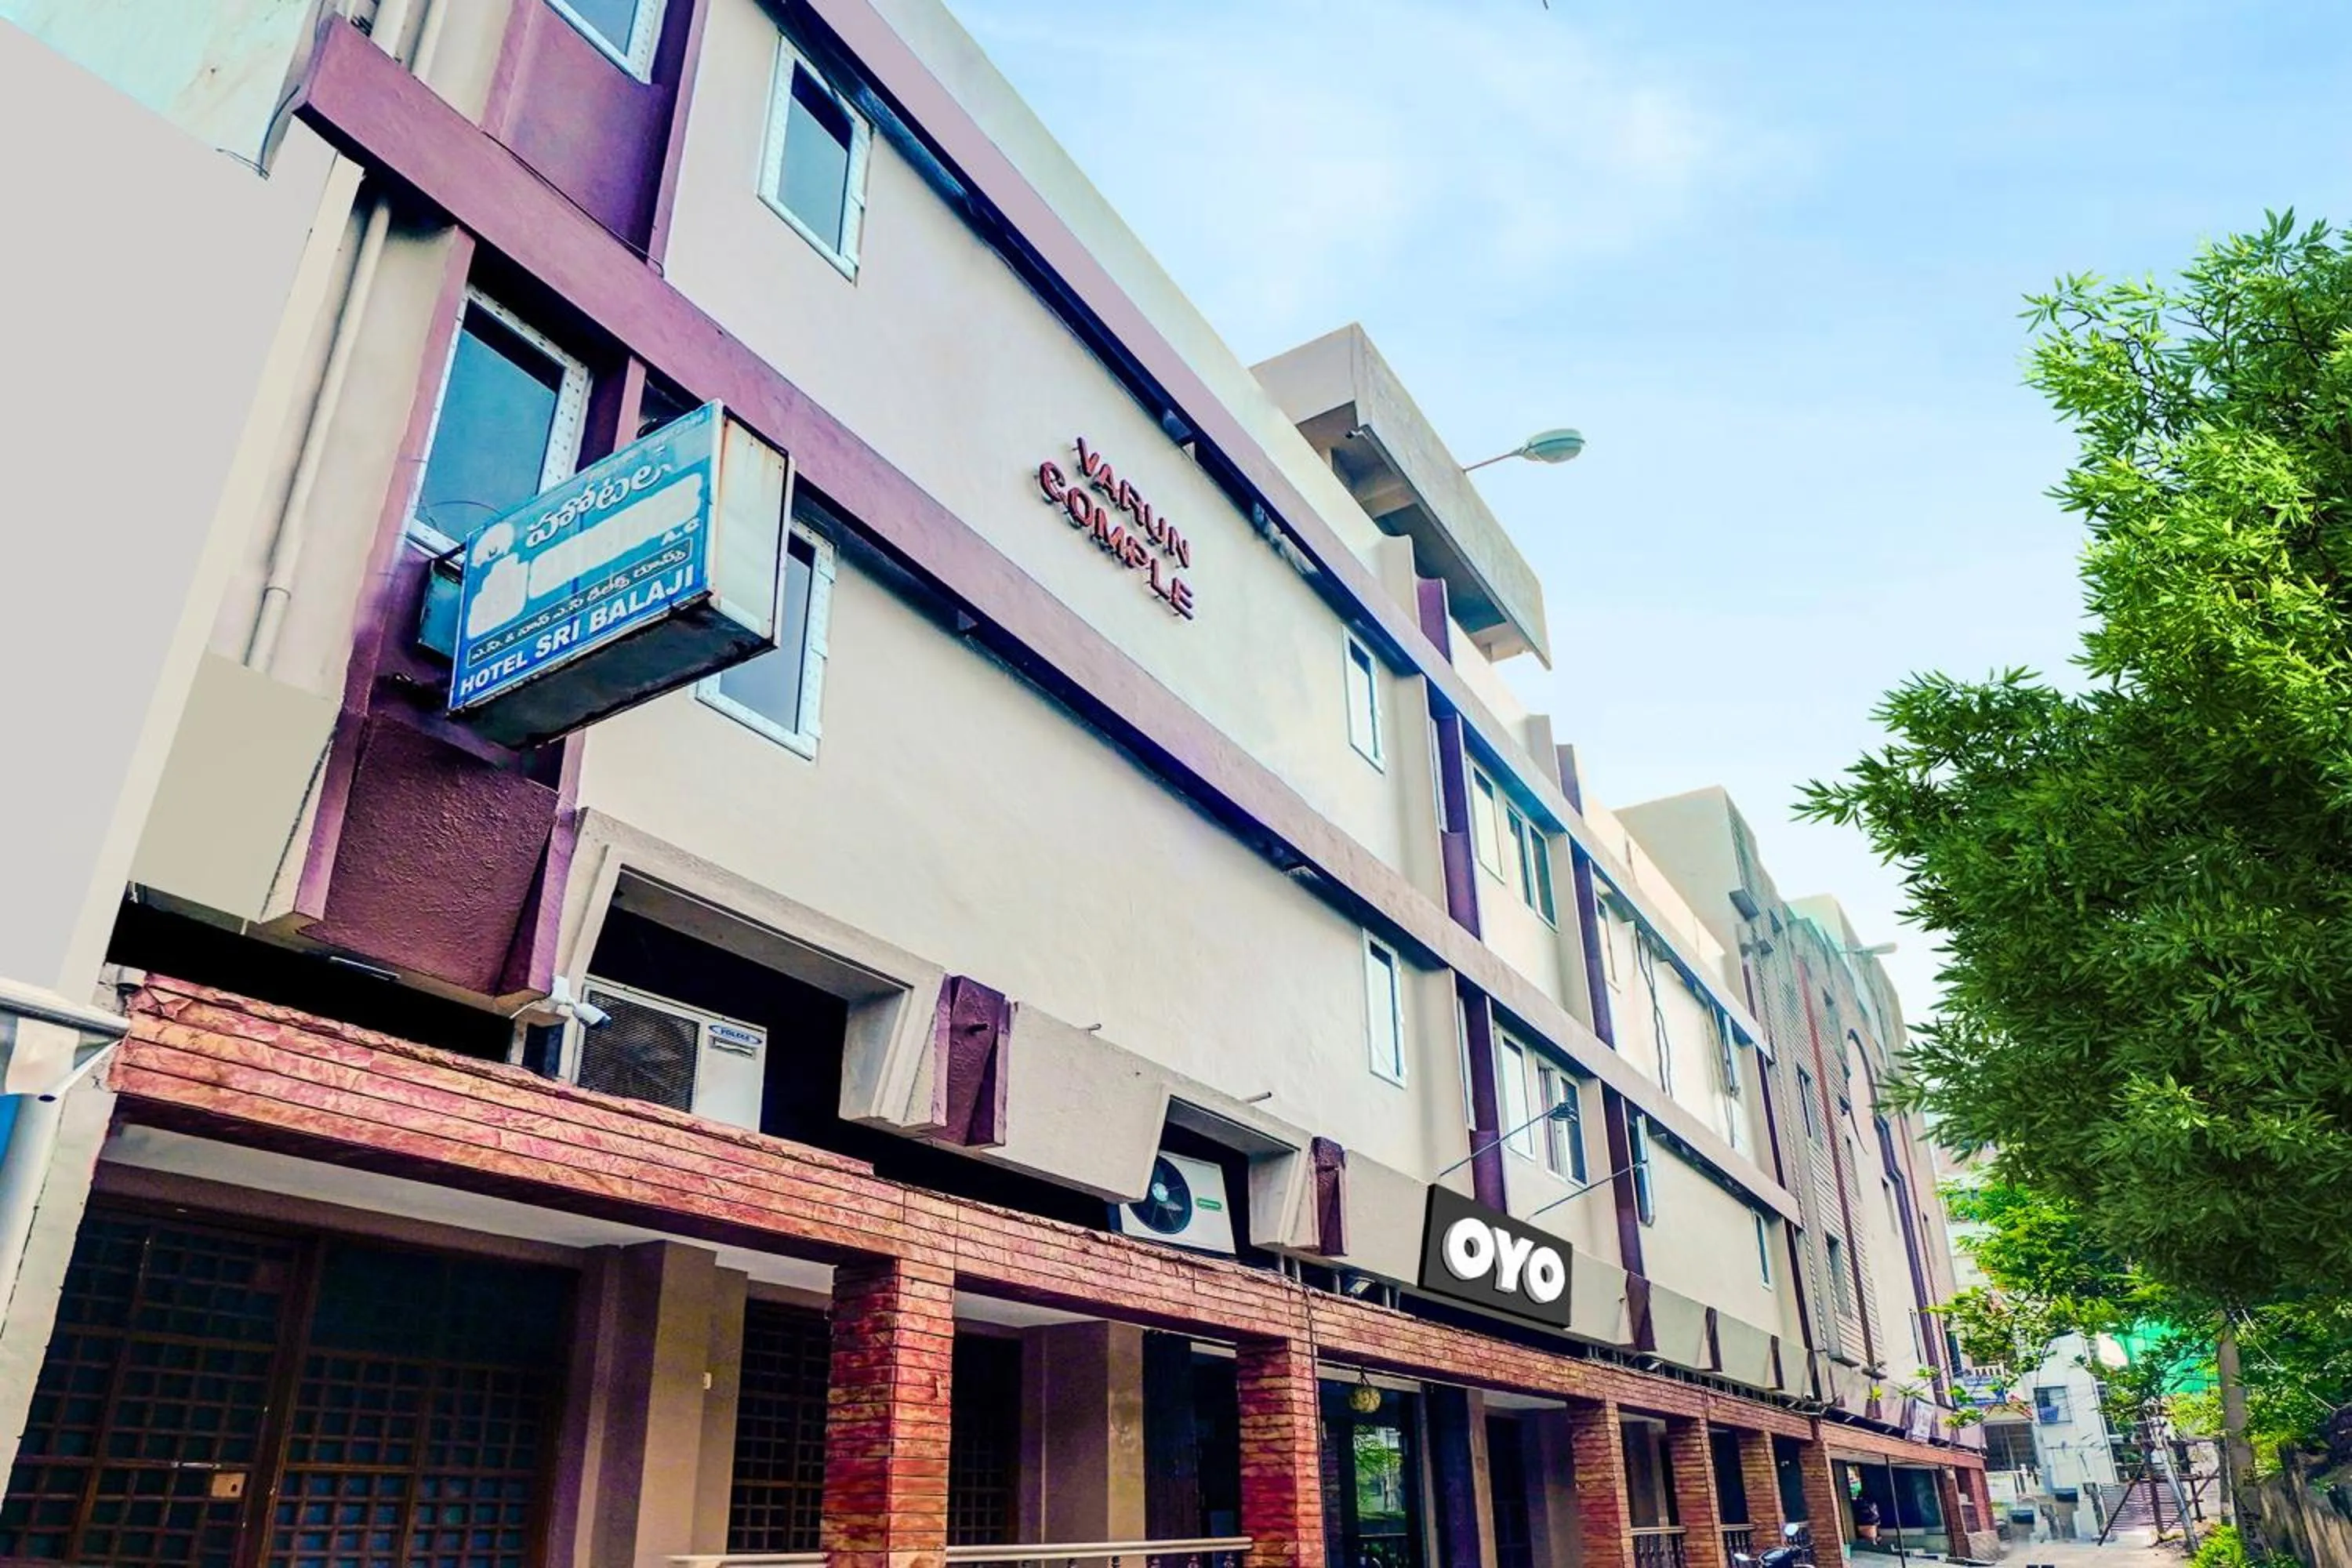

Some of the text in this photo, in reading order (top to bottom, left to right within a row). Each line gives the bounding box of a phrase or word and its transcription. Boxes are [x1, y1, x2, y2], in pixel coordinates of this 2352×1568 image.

[1039, 461, 1193, 620] COMPLE
[1076, 437, 1190, 568] VARUN
[459, 564, 694, 695] HOTEL SRI BALAJI
[1442, 1218, 1566, 1304] OYO
